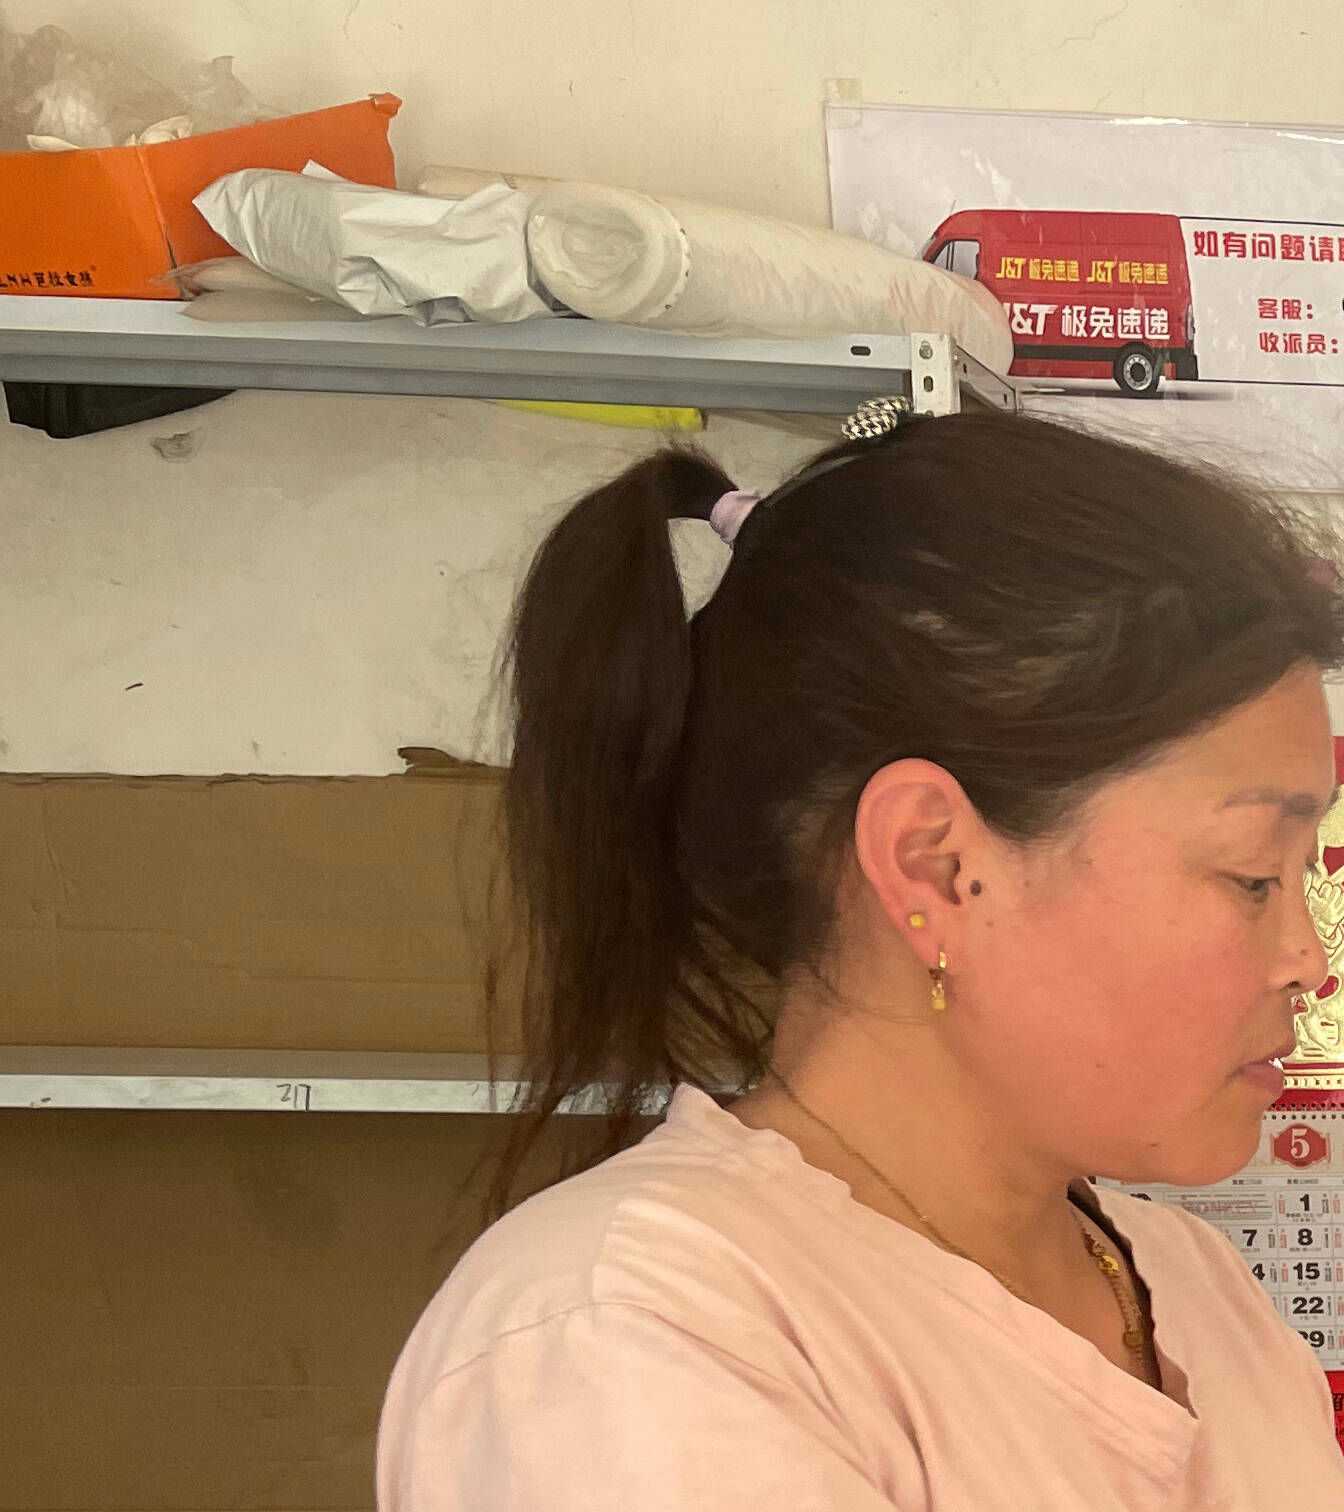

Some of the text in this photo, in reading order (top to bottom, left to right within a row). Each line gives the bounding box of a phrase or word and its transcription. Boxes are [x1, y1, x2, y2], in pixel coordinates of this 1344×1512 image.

[996, 257, 1026, 279] J&T
[1087, 261, 1116, 283] J&T
[1257, 297, 1314, 320] 客服：
[1061, 305, 1171, 340] 极兔速递
[1259, 332, 1340, 356] 收派员：
[1290, 1128, 1311, 1158] 5
[1299, 1193, 1311, 1212] 1
[1242, 1229, 1258, 1247] 7
[1297, 1228, 1314, 1247] 8
[1251, 1263, 1266, 1281] 4
[1293, 1262, 1321, 1280] 15
[1291, 1296, 1325, 1315] 22
